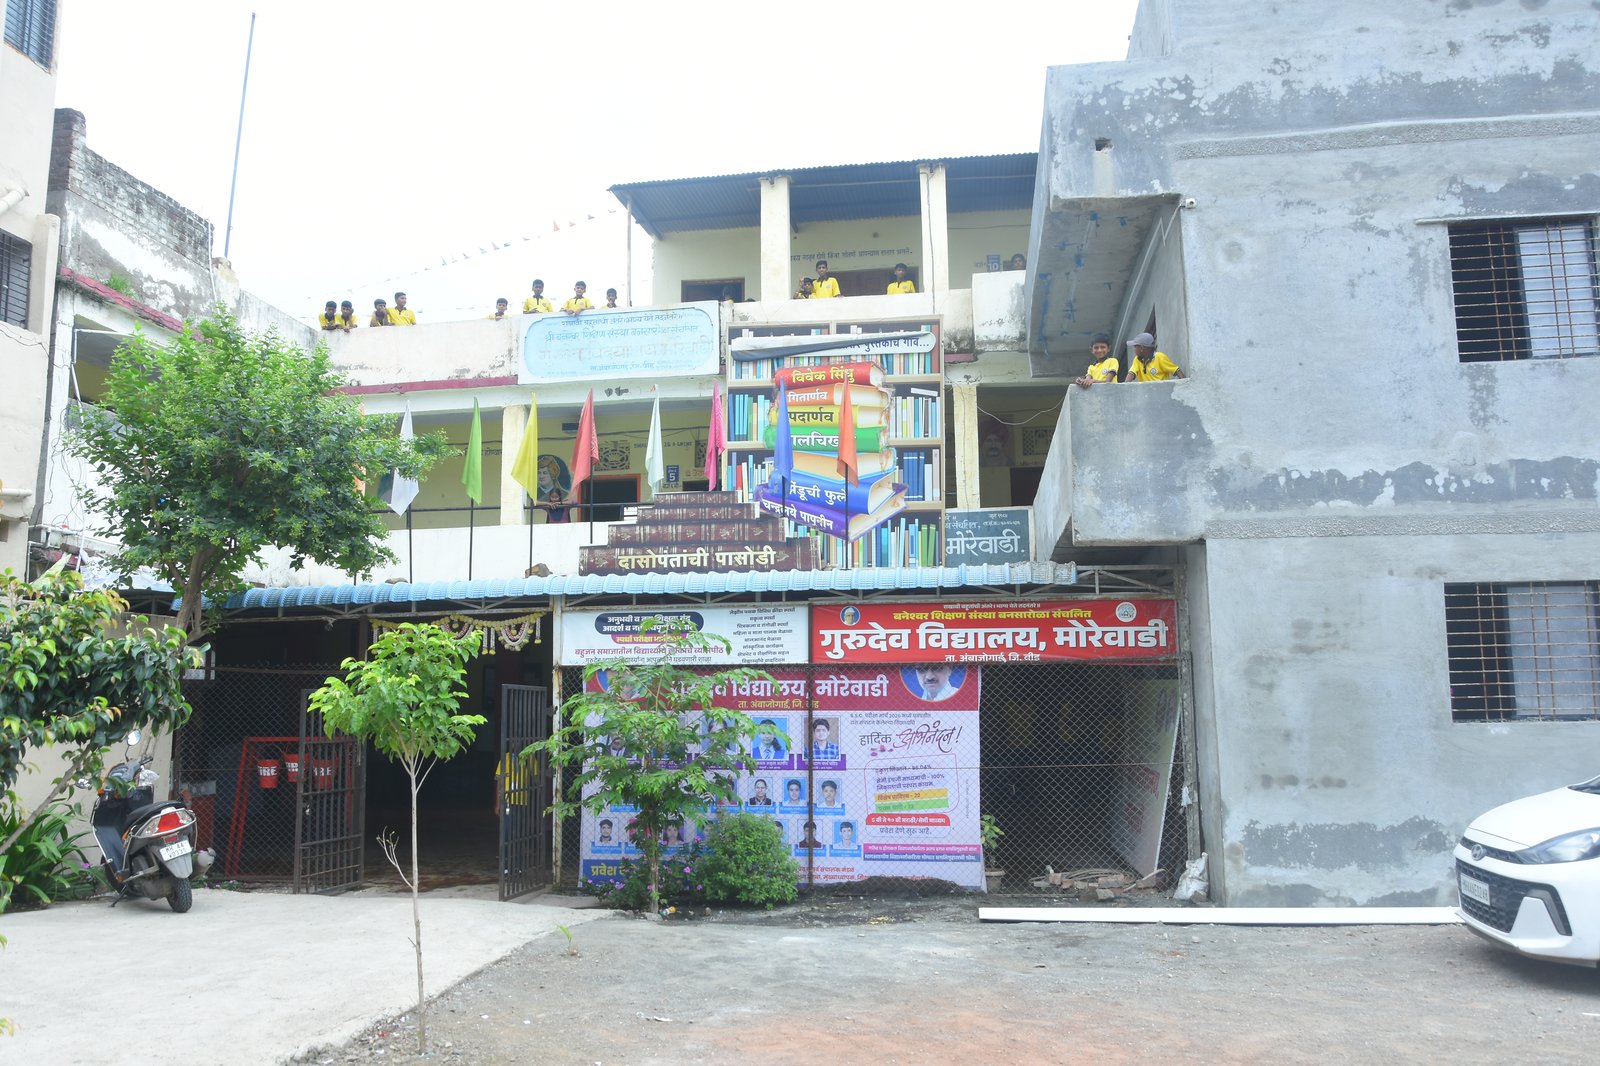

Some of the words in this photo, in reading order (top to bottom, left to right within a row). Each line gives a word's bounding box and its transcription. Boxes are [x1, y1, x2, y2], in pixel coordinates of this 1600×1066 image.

[792, 369, 826, 383] विवेक
[788, 389, 829, 403] गितार्णव
[788, 406, 834, 423] पदार्णव
[618, 549, 709, 570] दासोपंतांची
[715, 545, 776, 566] पासोडी
[607, 614, 633, 625] अनुभवी
[893, 611, 929, 620] बनेश्वर
[931, 609, 966, 620] शिक्षण
[968, 610, 996, 620] संस्था
[998, 609, 1050, 619] बनसारोळा
[1052, 608, 1093, 618] संचलित
[603, 623, 624, 632] आदर्श
[819, 622, 911, 659] गुरुदेव
[916, 622, 1047, 651] विद्यालय,
[1053, 619, 1169, 648] मोरेवाडी
[575, 648, 595, 658] बहुजन
[597, 646, 632, 655] समाजातील
[945, 654, 958, 662] ता.
[1008, 652, 1022, 661] जि.
[1023, 652, 1041, 661] बीड
[816, 675, 889, 697] मोरेवाडी
[859, 732, 892, 746] हार्दिक
[591, 862, 616, 876] प्रवेश
